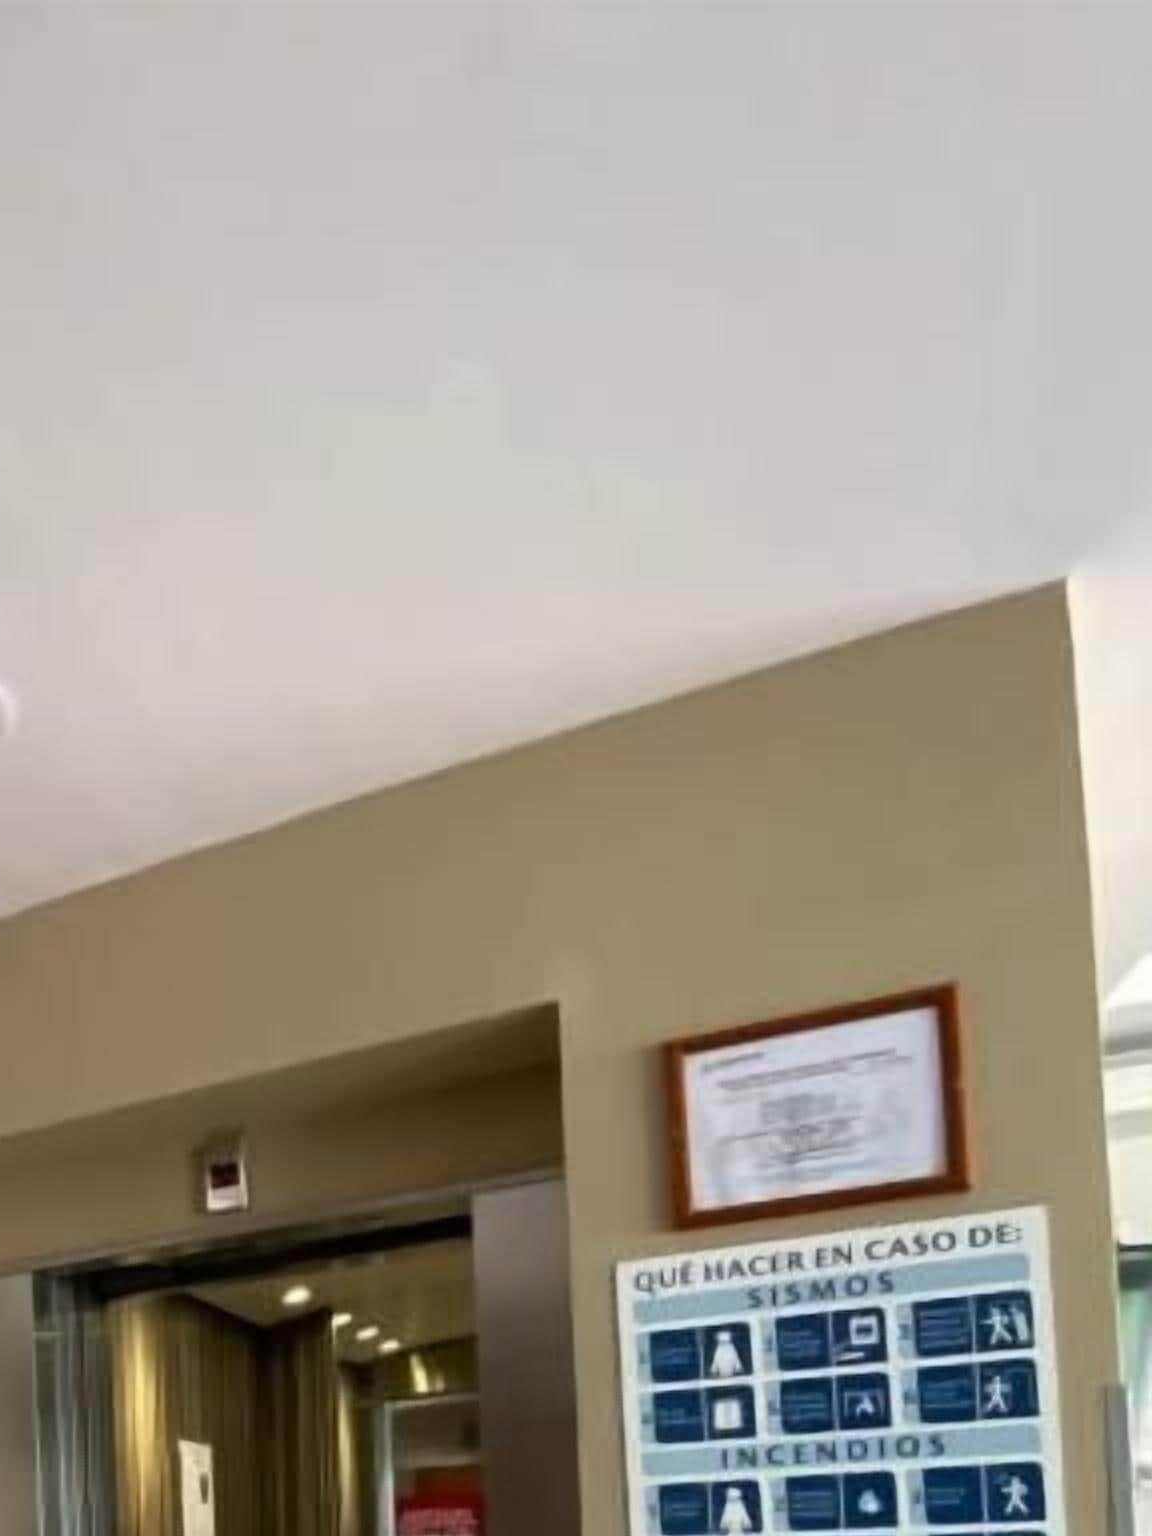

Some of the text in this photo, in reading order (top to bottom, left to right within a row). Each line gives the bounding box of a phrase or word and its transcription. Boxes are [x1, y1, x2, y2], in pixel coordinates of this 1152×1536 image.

[634, 1260, 694, 1295] QUÉ
[704, 1250, 805, 1283] HACER
[815, 1242, 853, 1269] EN
[864, 1232, 957, 1261] CASO
[748, 1271, 895, 1309] SISMOS
[721, 1434, 946, 1470] INCENDIOS
